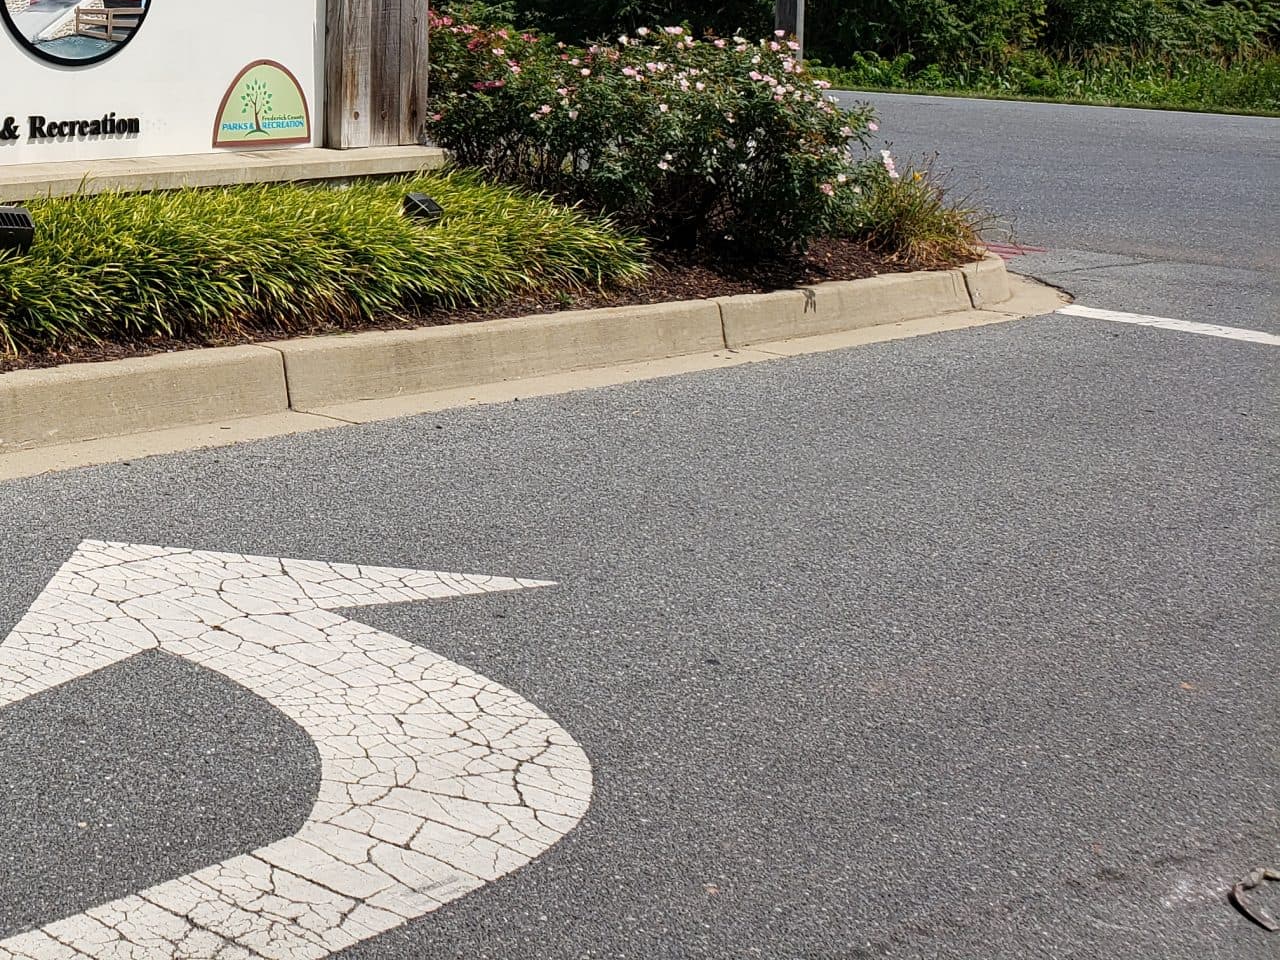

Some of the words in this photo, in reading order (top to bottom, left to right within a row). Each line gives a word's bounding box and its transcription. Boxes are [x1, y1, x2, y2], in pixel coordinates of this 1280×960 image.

[28, 112, 140, 140] Recreation
[222, 122, 248, 131] PARKS
[262, 120, 304, 129] RECREATION
